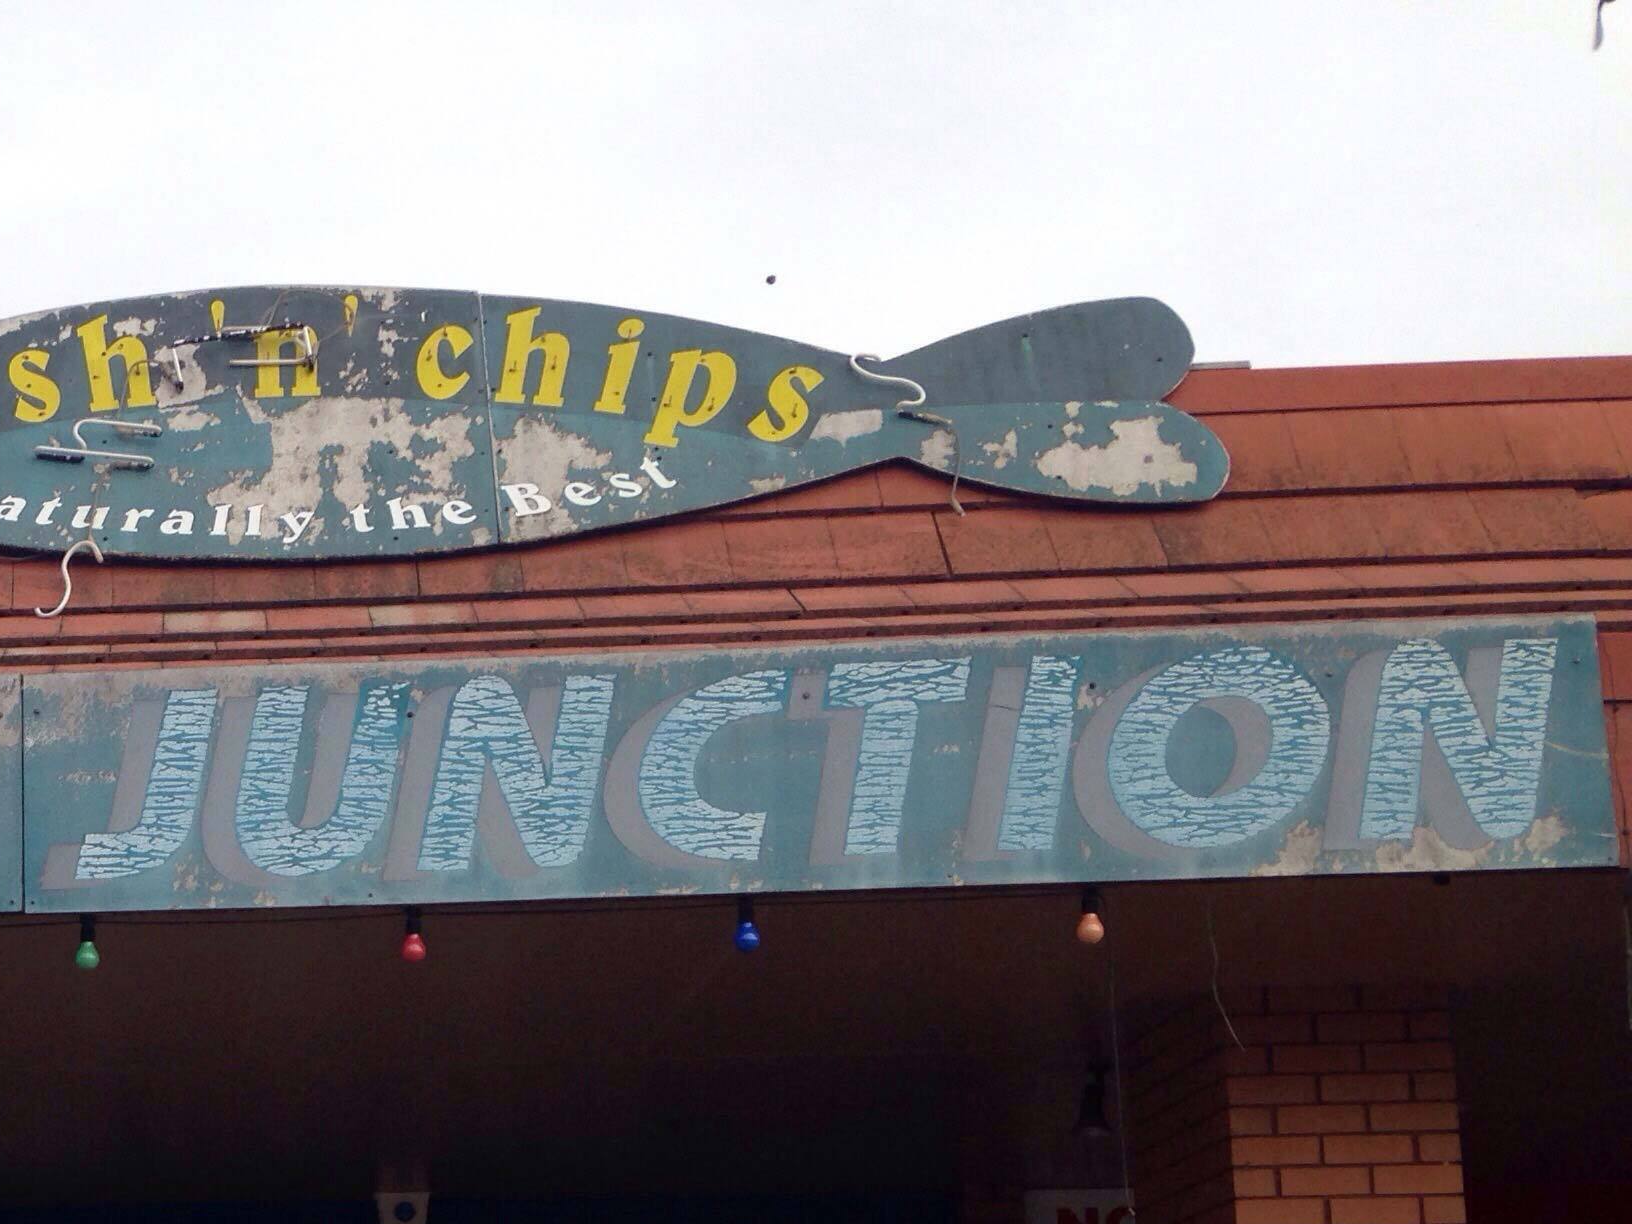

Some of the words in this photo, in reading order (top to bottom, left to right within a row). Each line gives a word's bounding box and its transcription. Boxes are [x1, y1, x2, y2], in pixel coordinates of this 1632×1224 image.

[414, 306, 825, 449] chips
[352, 498, 476, 533] the
[501, 455, 677, 518] Best
[48, 637, 1559, 885] JUNCTION
